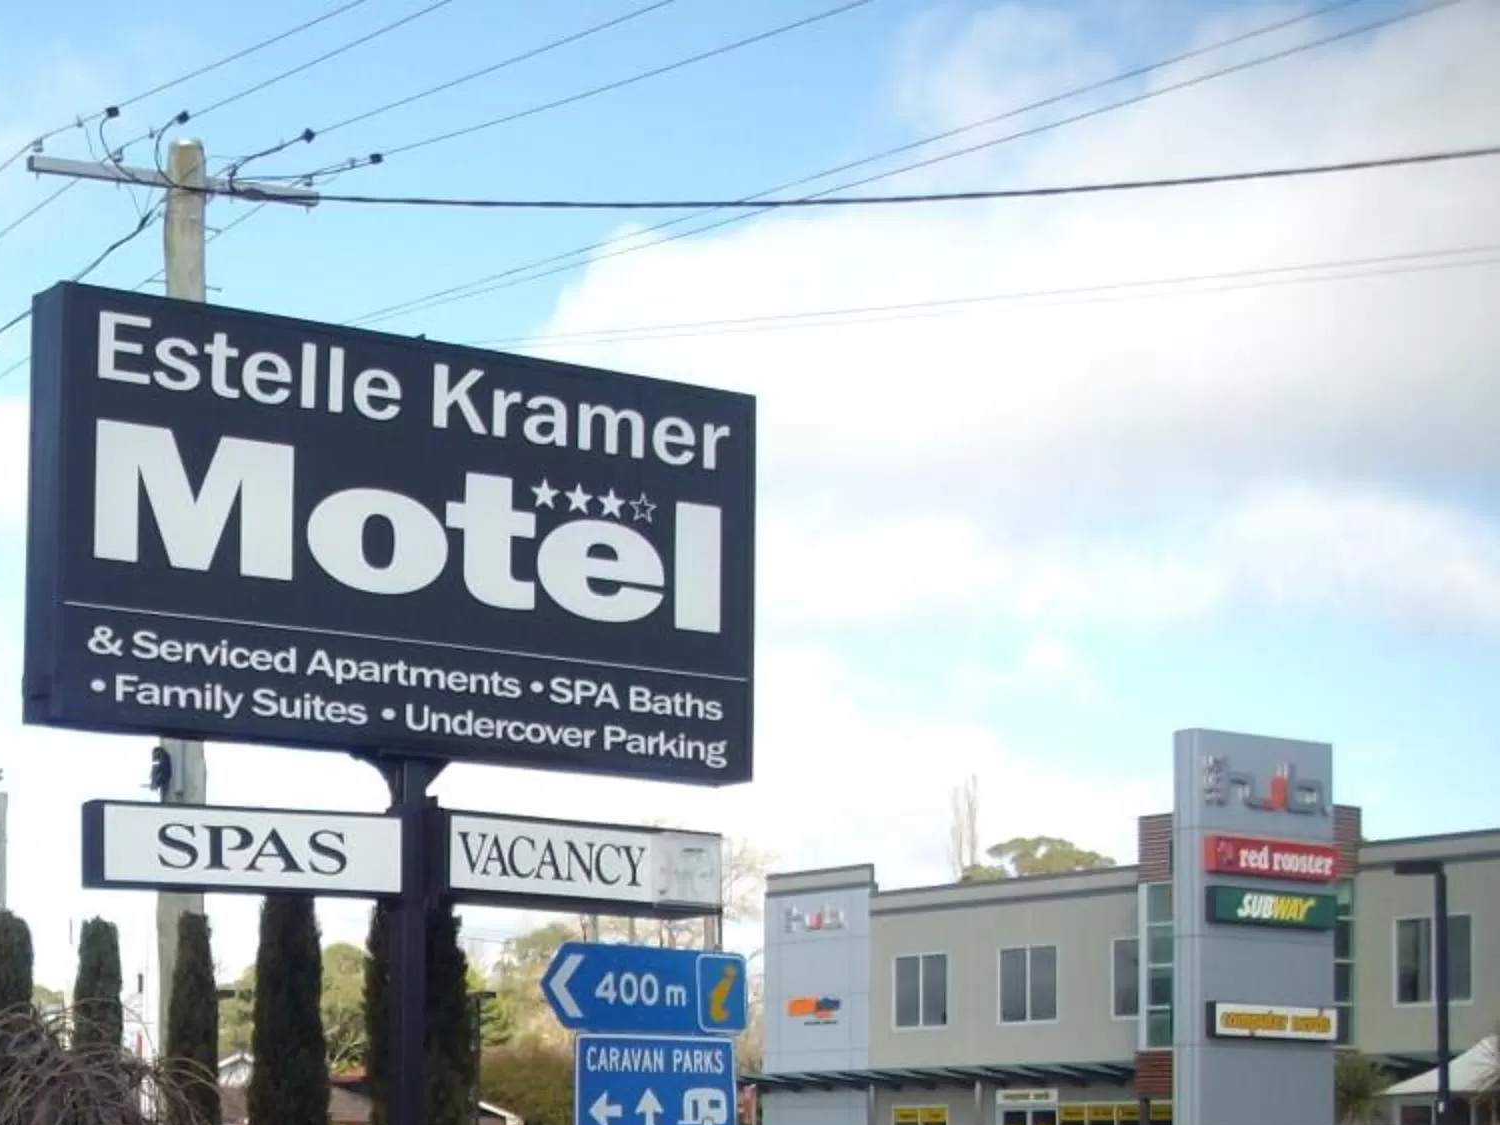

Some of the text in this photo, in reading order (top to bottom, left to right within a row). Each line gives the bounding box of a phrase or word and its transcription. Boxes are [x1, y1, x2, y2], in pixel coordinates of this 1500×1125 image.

[97, 310, 731, 470] Estelle Kramer
[94, 417, 723, 634] Motel
[87, 625, 724, 721] & Serviced Apartments SPA Baths
[114, 674, 728, 768] Family Suites Undercover Parking
[157, 822, 348, 876] SPAS
[457, 830, 647, 887] VACANCY
[1238, 845, 1333, 876] red rooster
[1236, 891, 1317, 921] SUBWAY
[585, 1045, 725, 1075] CARAVAN PARKS
